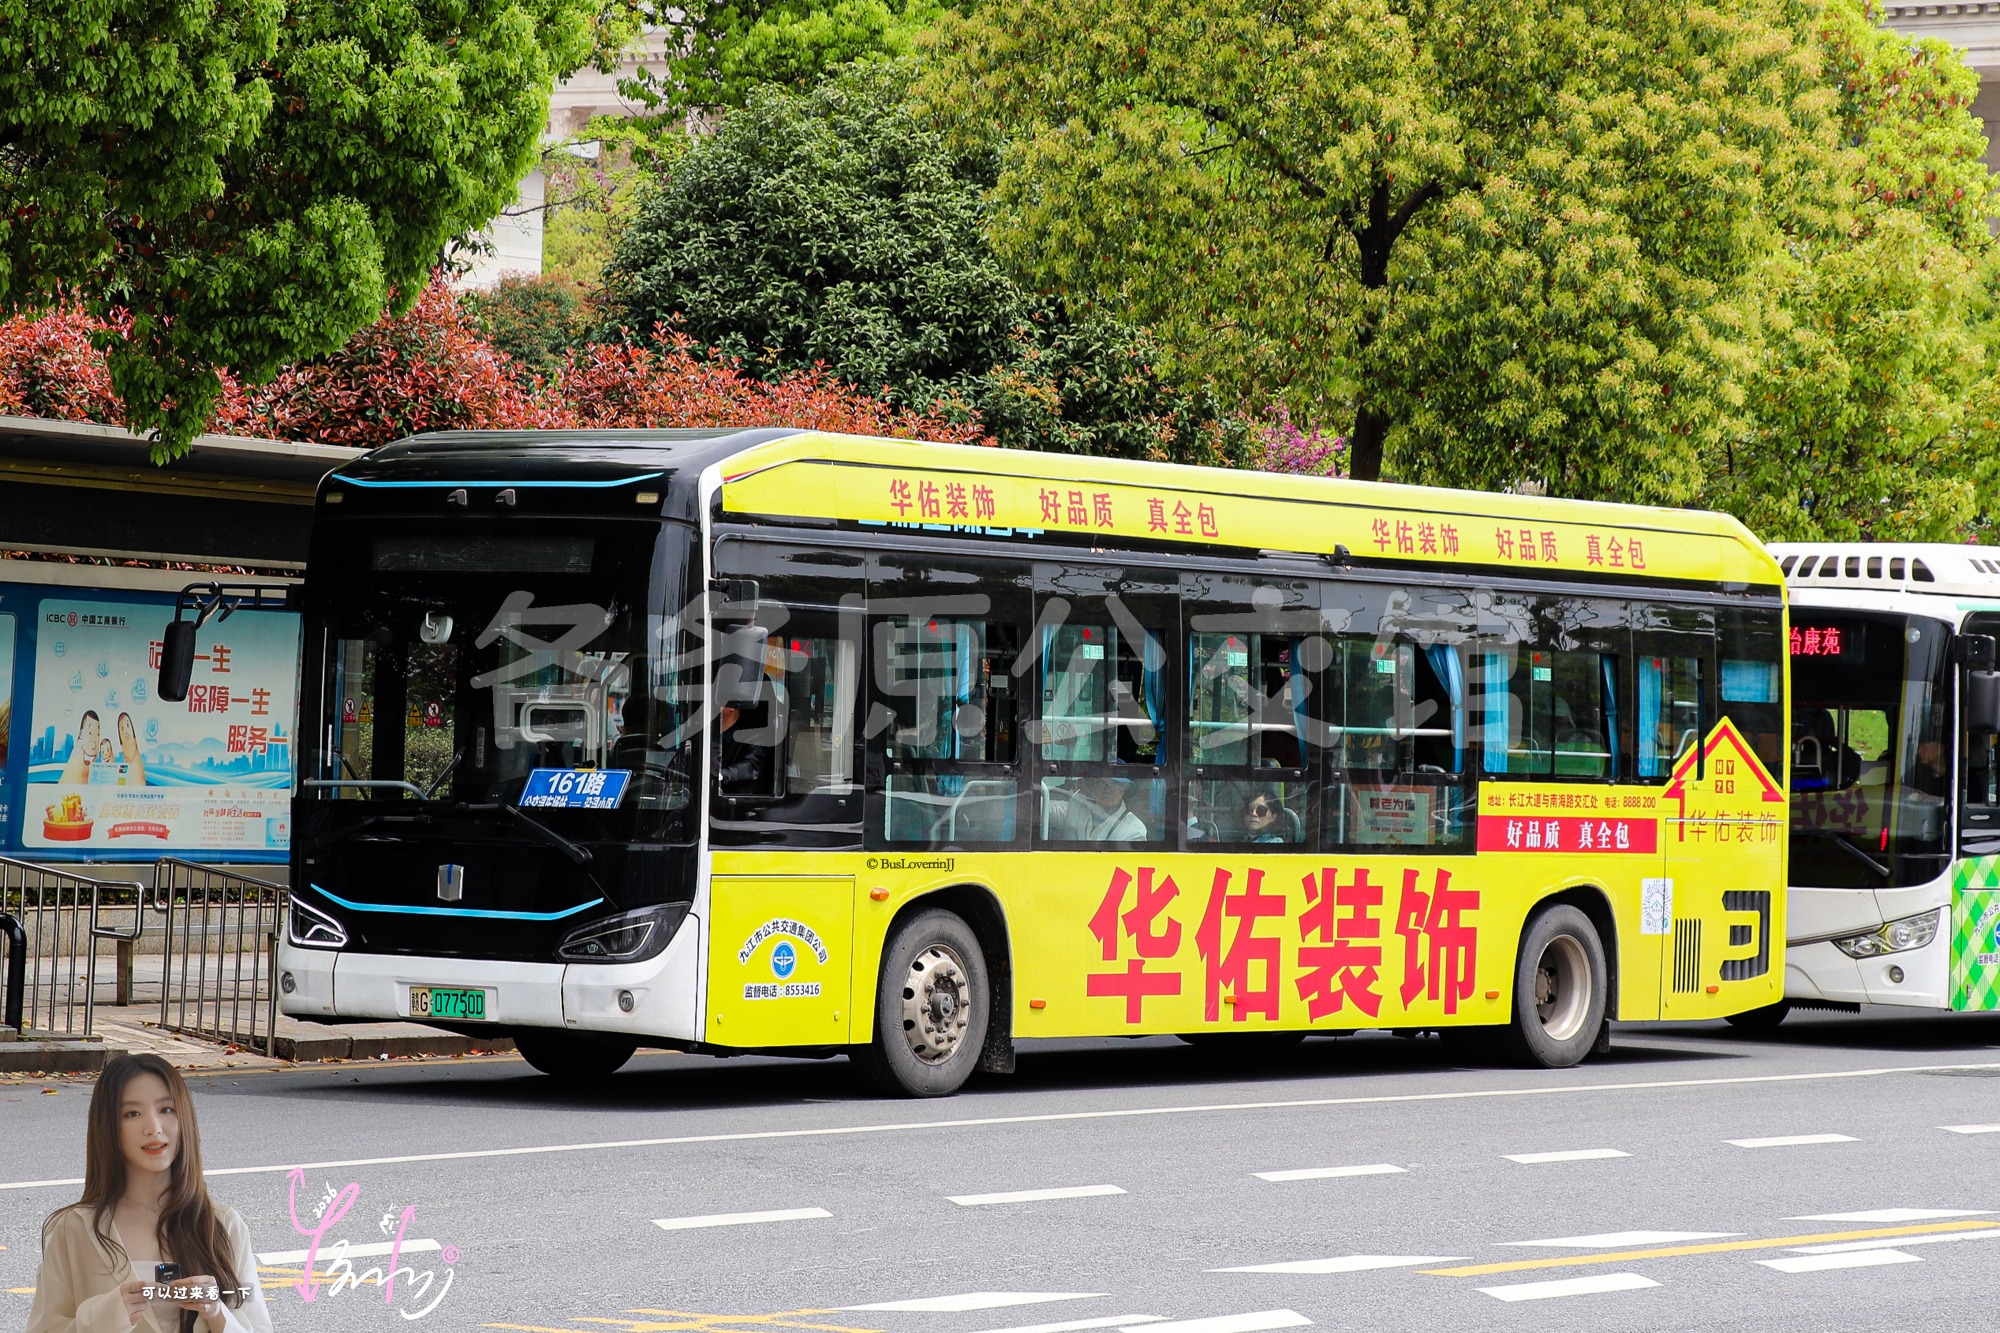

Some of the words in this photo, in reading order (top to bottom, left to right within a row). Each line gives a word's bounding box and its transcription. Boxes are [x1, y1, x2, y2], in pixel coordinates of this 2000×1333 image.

[889, 478, 995, 521] 华佑装饰
[1039, 487, 1114, 529] 好品质
[1147, 497, 1219, 538] 真全包
[1371, 518, 1460, 557] 华佑装饰
[1496, 526, 1559, 563] 好品质
[1586, 534, 1646, 570] 真全包
[46, 613, 66, 623] ICBC
[81, 614, 126, 626] 中国工商银行
[148, 640, 232, 673] 记一生
[187, 684, 271, 716] 保障一生
[226, 724, 292, 754] 服务一
[548, 772, 607, 795] 161路
[1506, 819, 1561, 849] 好品质
[1578, 820, 1631, 849] 真全包
[1689, 808, 1777, 845] 华佑装饰
[739, 919, 828, 964] 九江市公共交通集团公司
[1086, 866, 1481, 1025] 华佑装饰
